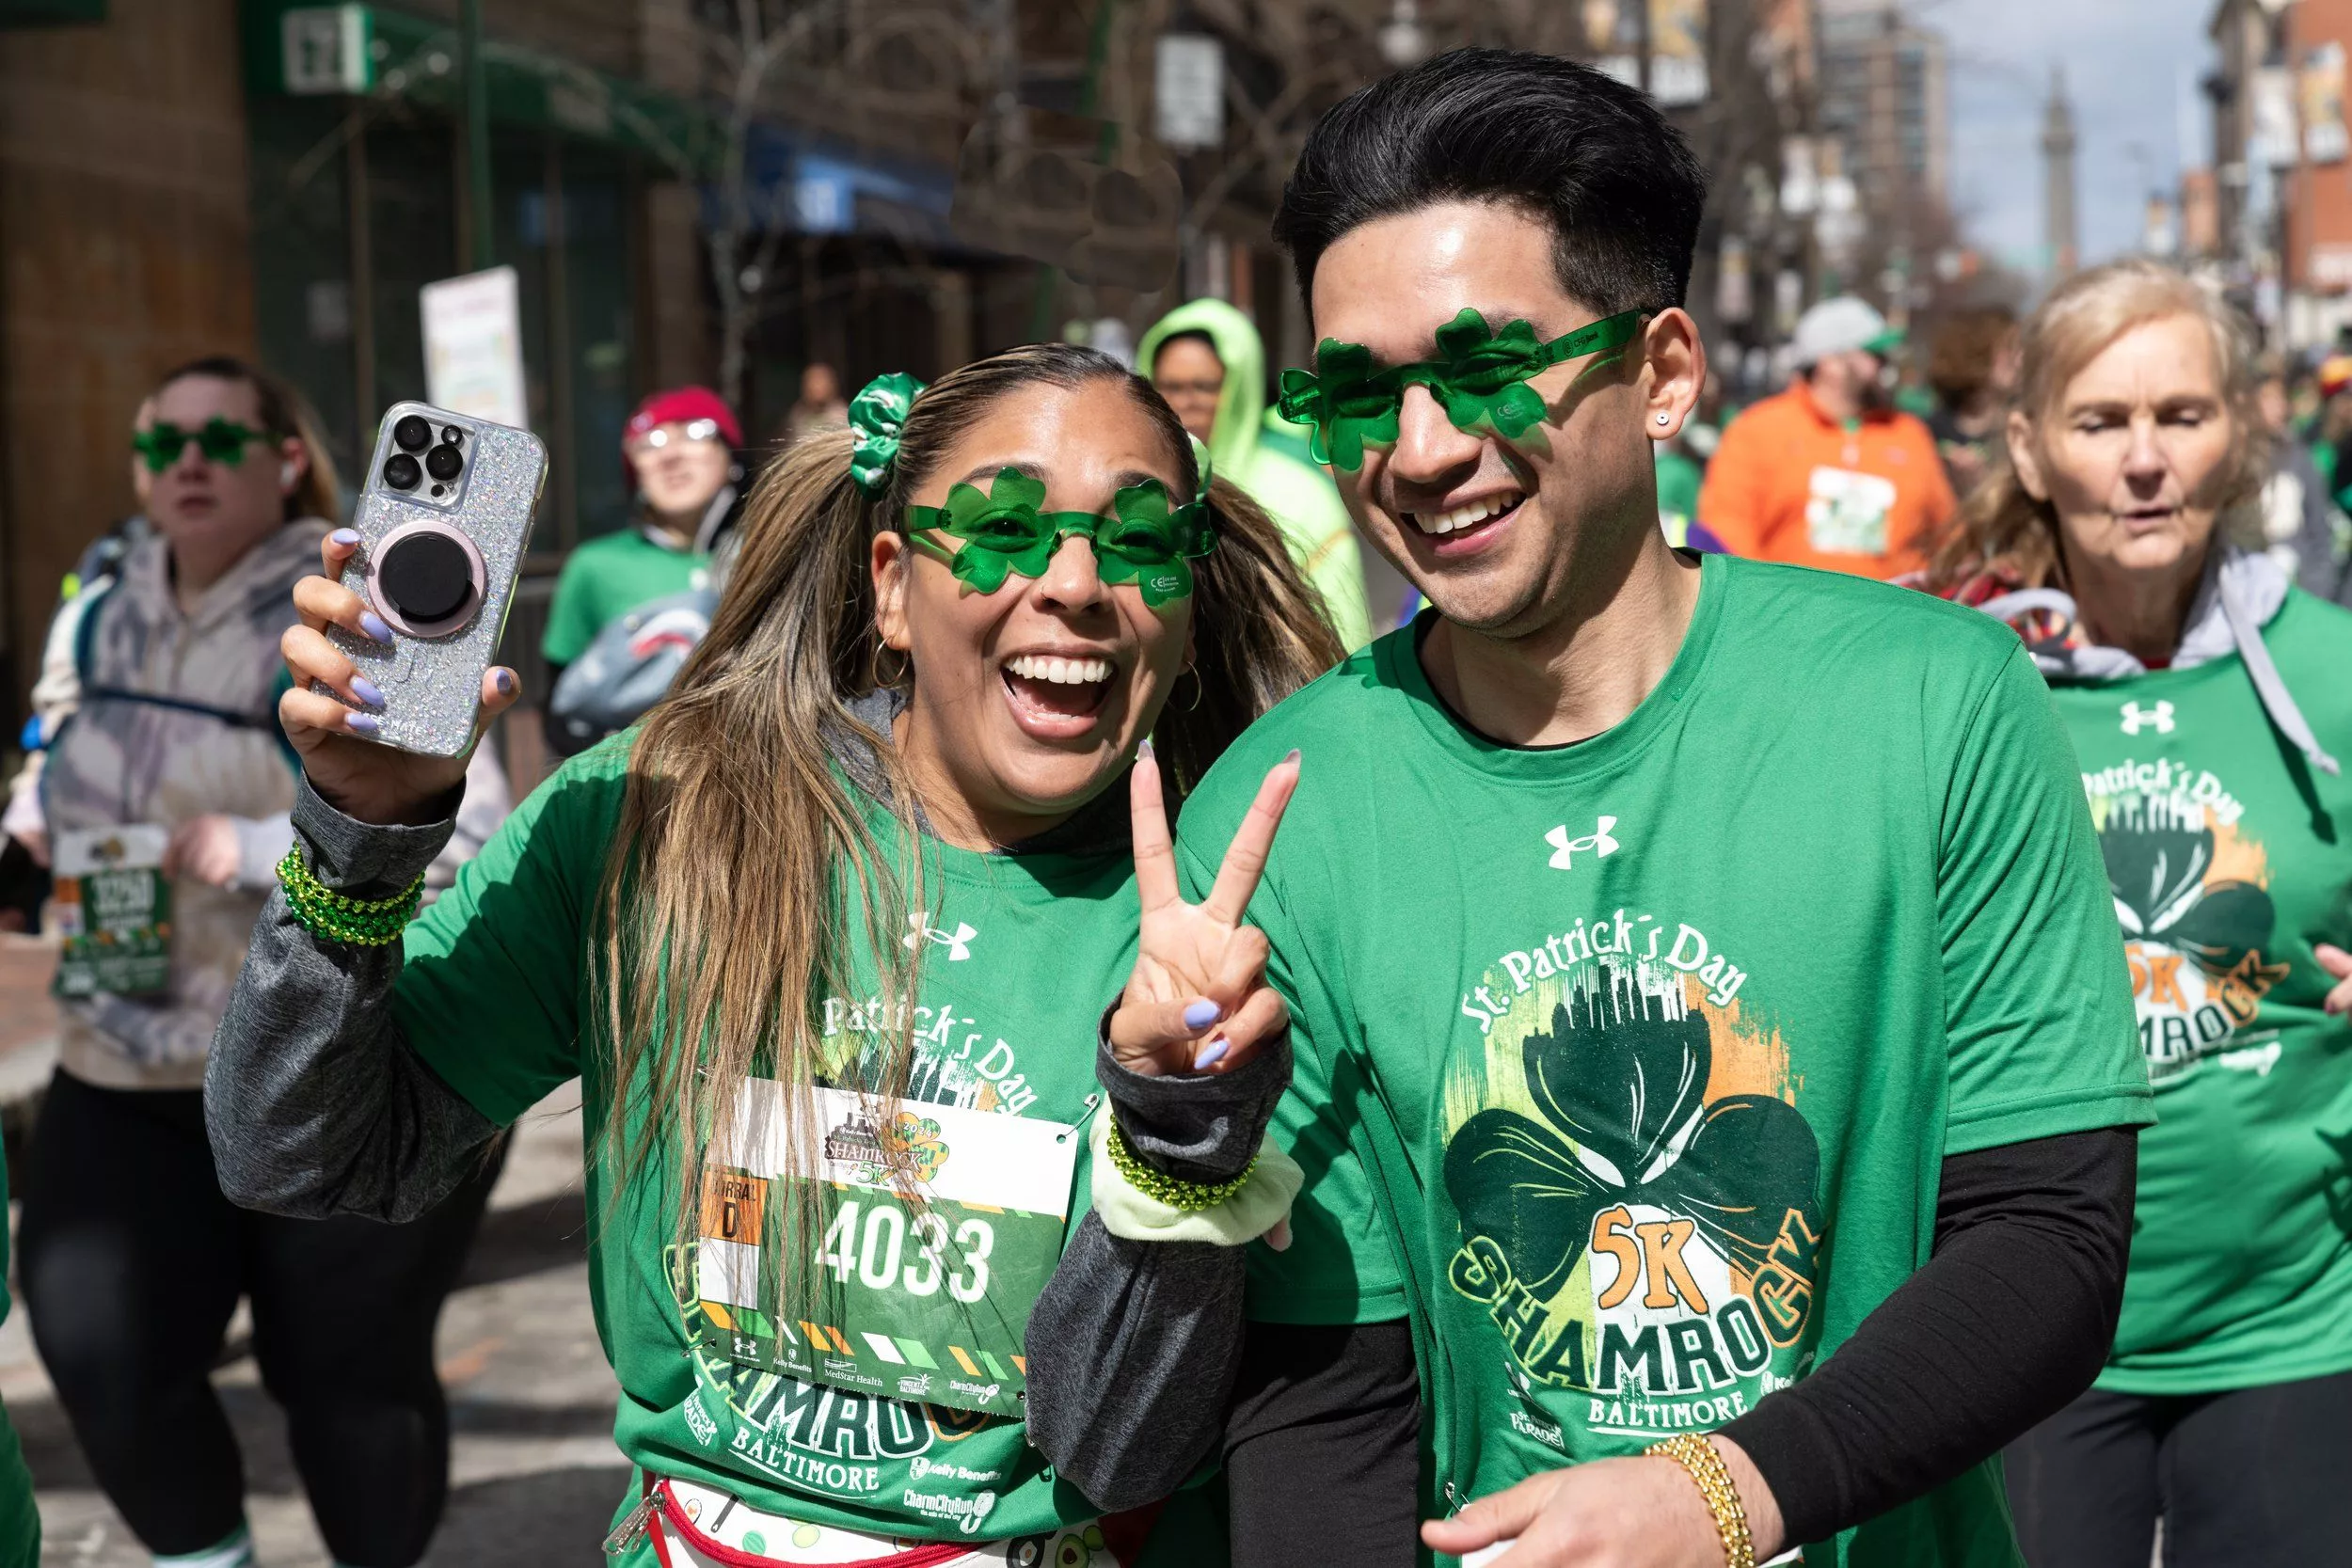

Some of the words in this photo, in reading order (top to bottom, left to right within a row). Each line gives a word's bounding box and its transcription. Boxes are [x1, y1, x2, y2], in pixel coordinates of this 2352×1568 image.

[1461, 986, 1510, 1035] St.
[1664, 923, 1747, 1006] Day
[974, 1038, 1038, 1117] Day
[903, 1122, 932, 1138] 2024
[856, 1160, 889, 1186] 5K
[723, 1202, 739, 1238] D
[814, 1200, 994, 1304] 4033
[1591, 1205, 1709, 1314] 5K
[1449, 1208, 1820, 1396] SHAMROCK
[773, 1358, 789, 1369] Kelly
[788, 1362, 812, 1372] Benefits
[825, 1369, 855, 1382] MedStar
[856, 1375, 882, 1386] Health
[1588, 1391, 1748, 1428] BALTIMORE
[731, 1426, 880, 1492] BALTIMORE
[928, 1464, 957, 1479] Kelly
[958, 1466, 1002, 1481] Benefits
[904, 1489, 974, 1515] CharmCityRun
